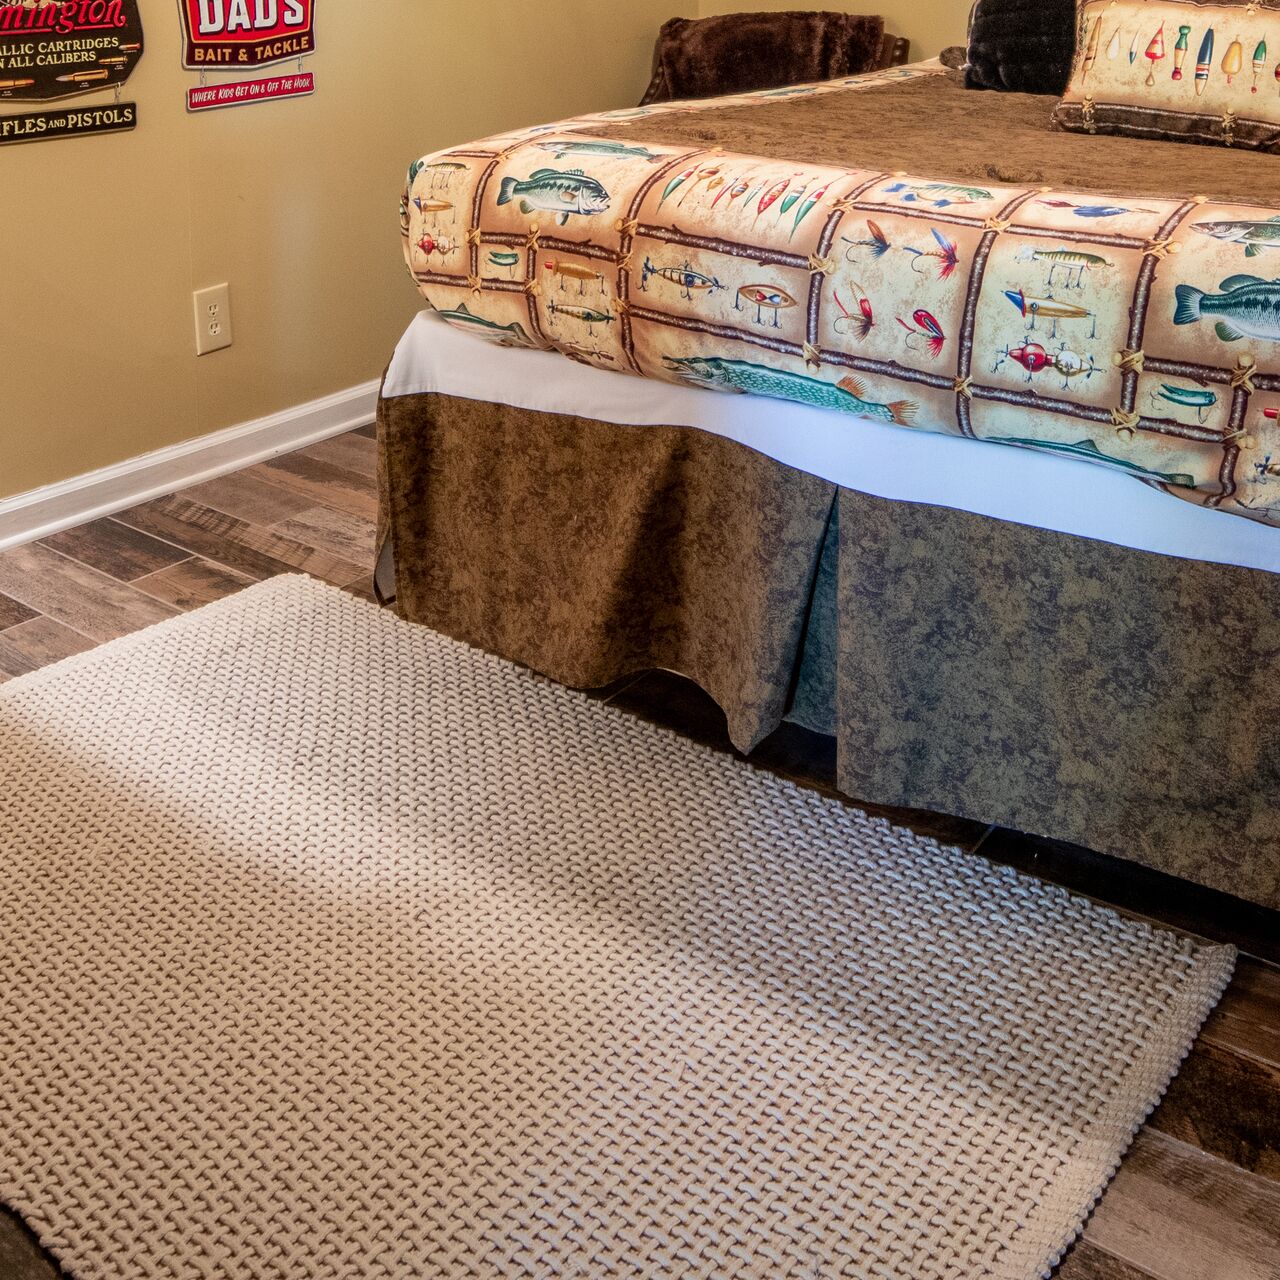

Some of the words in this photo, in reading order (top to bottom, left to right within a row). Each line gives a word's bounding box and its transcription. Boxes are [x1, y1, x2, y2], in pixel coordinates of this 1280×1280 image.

[38, 37, 119, 53] CARTRIDGES
[194, 48, 232, 62] BAIT
[238, 48, 248, 61] &
[255, 36, 309, 59] TACKLE
[8, 55, 34, 68] ALL
[36, 51, 97, 66] CALIBERS
[192, 90, 216, 103] WHERE
[218, 88, 234, 99] KIDS
[235, 86, 249, 97] GET
[250, 84, 260, 95] ON
[260, 85, 265, 93] &
[267, 82, 279, 92] OFF
[281, 79, 293, 90] THE
[293, 77, 310, 88] HOOK
[48, 118, 66, 129] AND
[67, 108, 133, 129] PISTOLS
